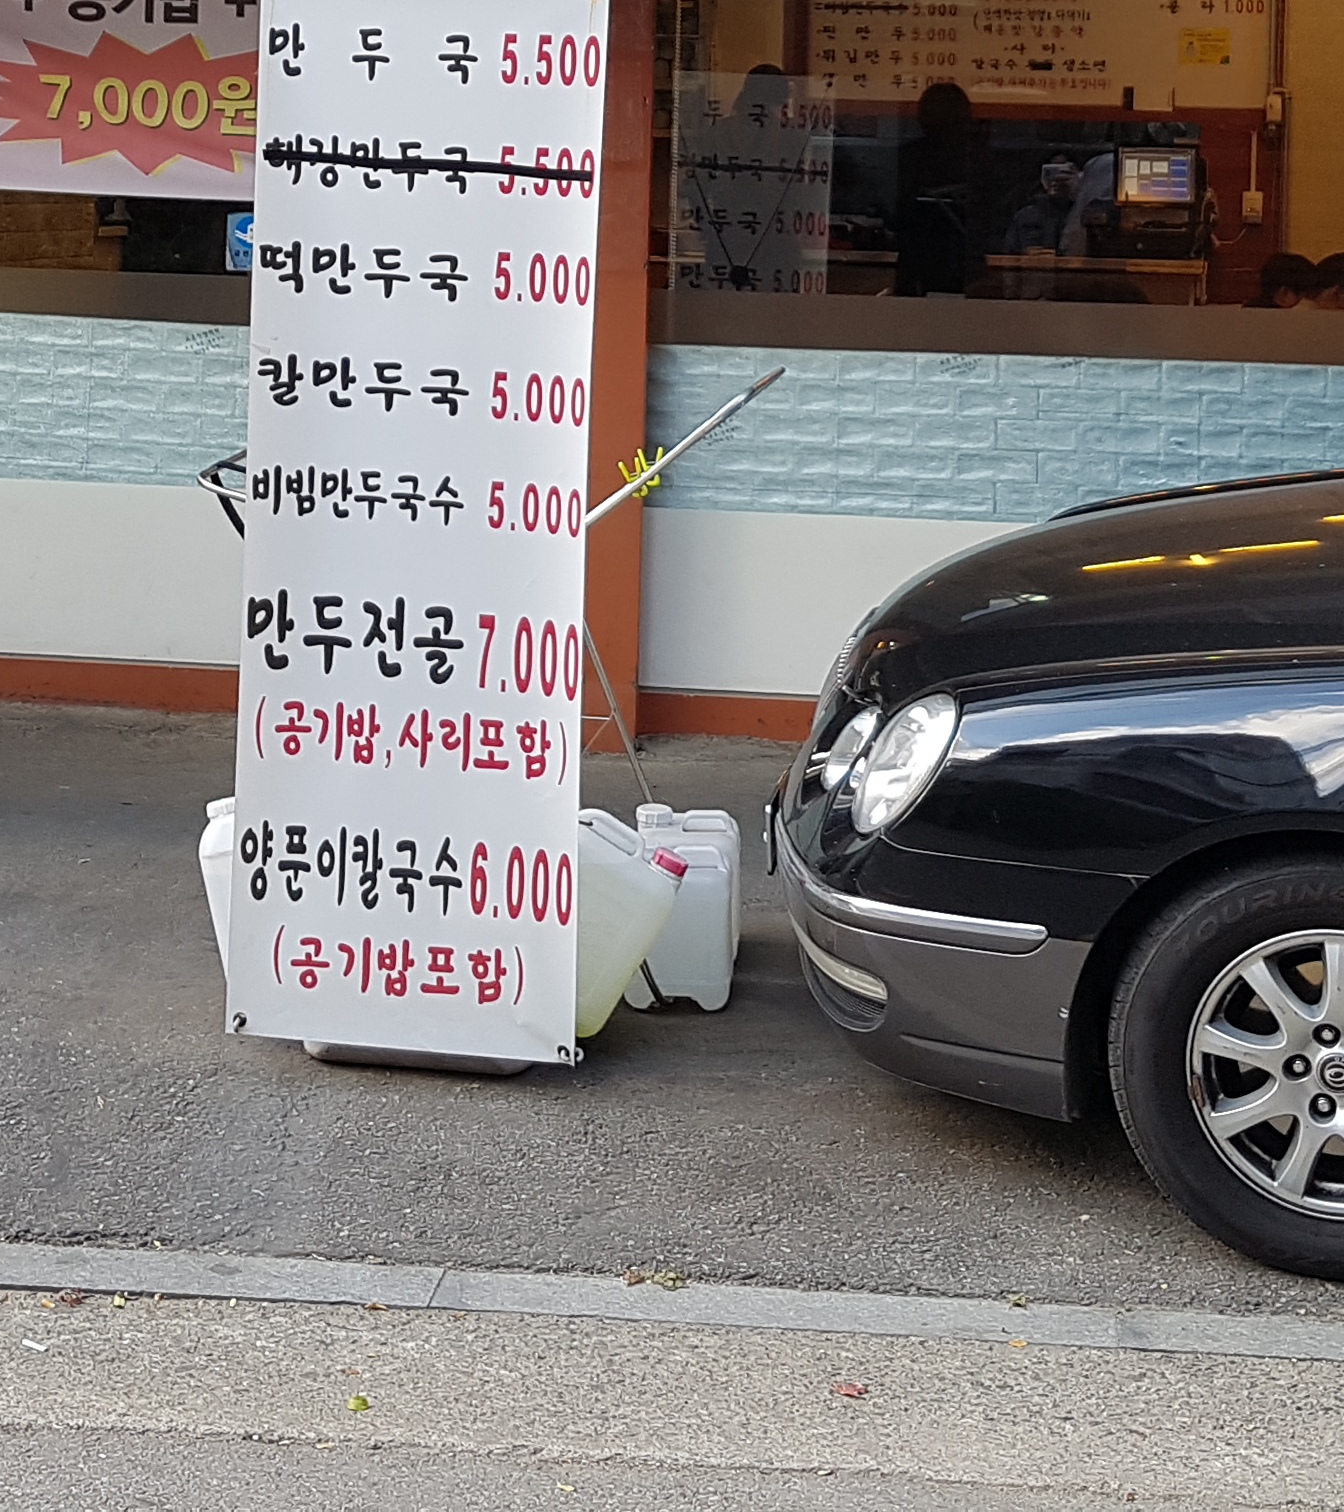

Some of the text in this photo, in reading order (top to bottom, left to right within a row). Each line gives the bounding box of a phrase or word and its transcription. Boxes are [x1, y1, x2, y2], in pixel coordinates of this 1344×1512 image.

[501, 33, 601, 87] 5.500
[38, 73, 257, 136] 7,000원
[259, 241, 591, 306] 떡만두국 5.000
[257, 353, 586, 427] 칼만두국 5.000
[252, 465, 582, 538] 비빔만두국수 5.000
[247, 588, 580, 701] 만두전골 7.000
[470, 841, 573, 926] 6.000
